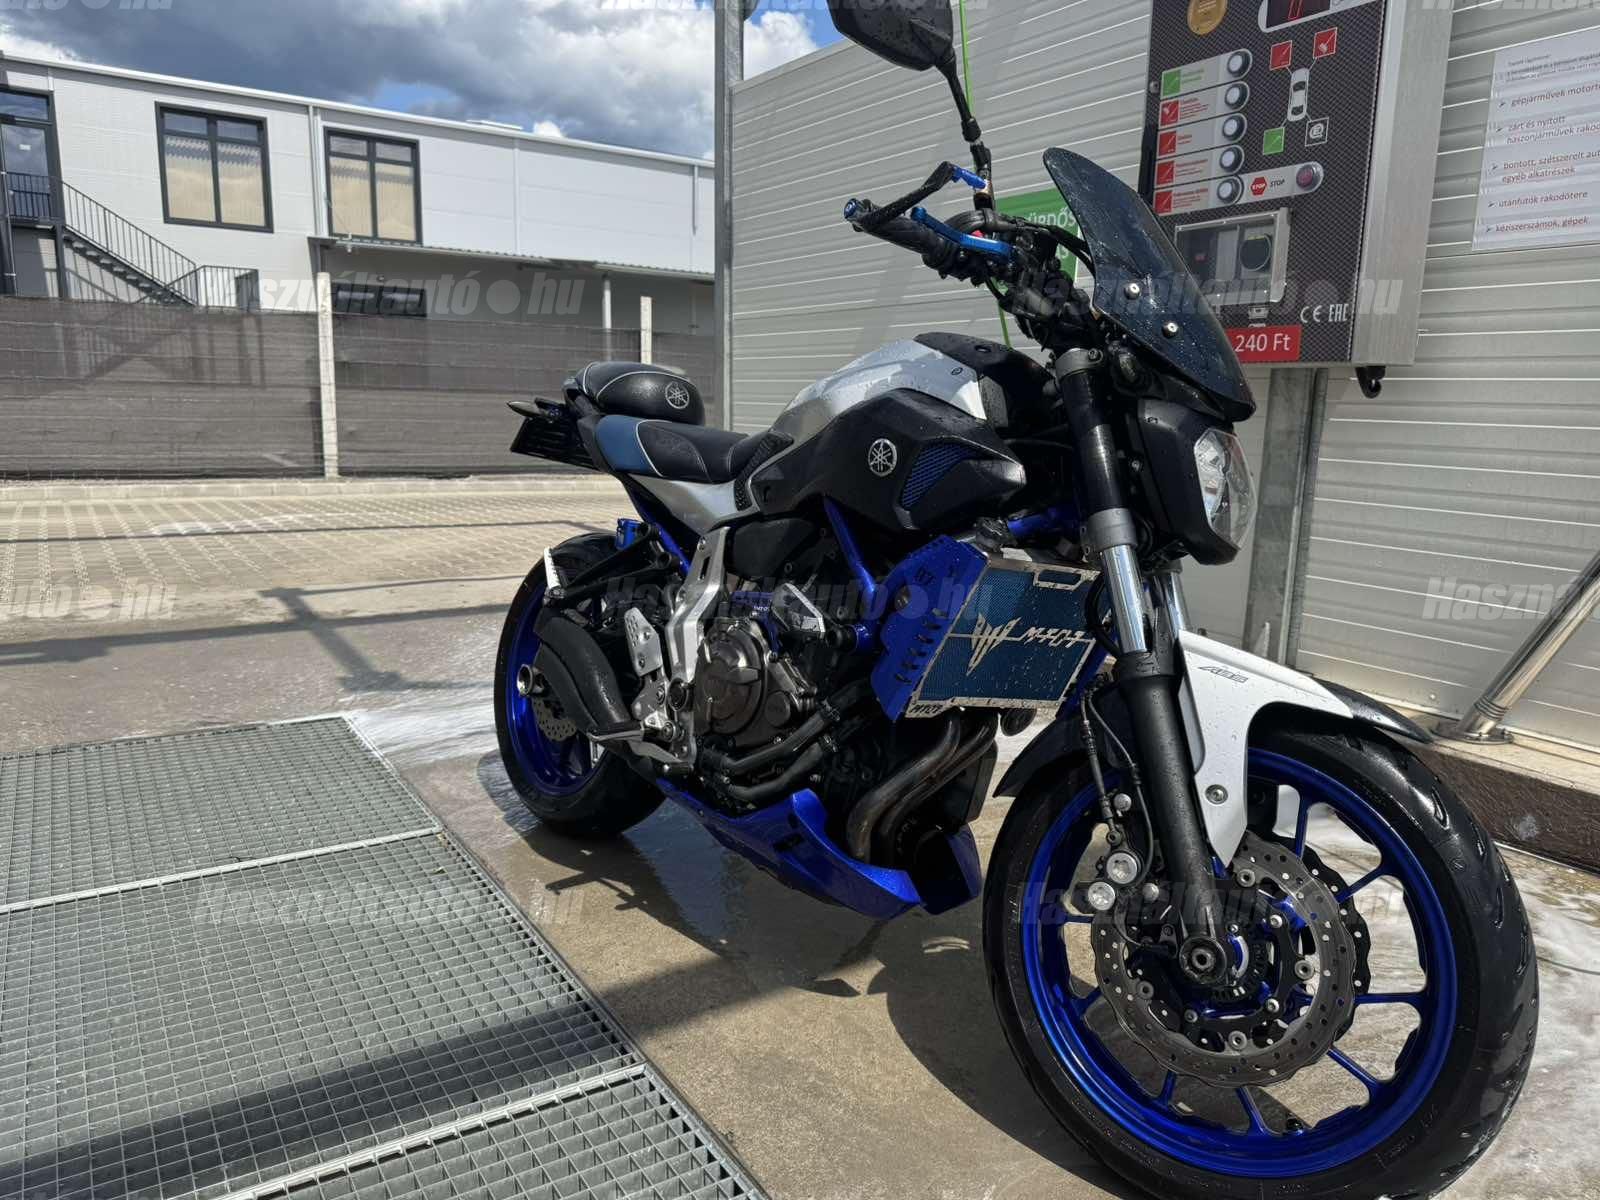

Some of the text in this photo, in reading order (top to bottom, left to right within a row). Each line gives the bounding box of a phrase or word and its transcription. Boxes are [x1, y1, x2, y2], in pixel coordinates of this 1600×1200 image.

[1270, 179, 1285, 187] STOP
[1234, 332, 1291, 353] 240 Ft
